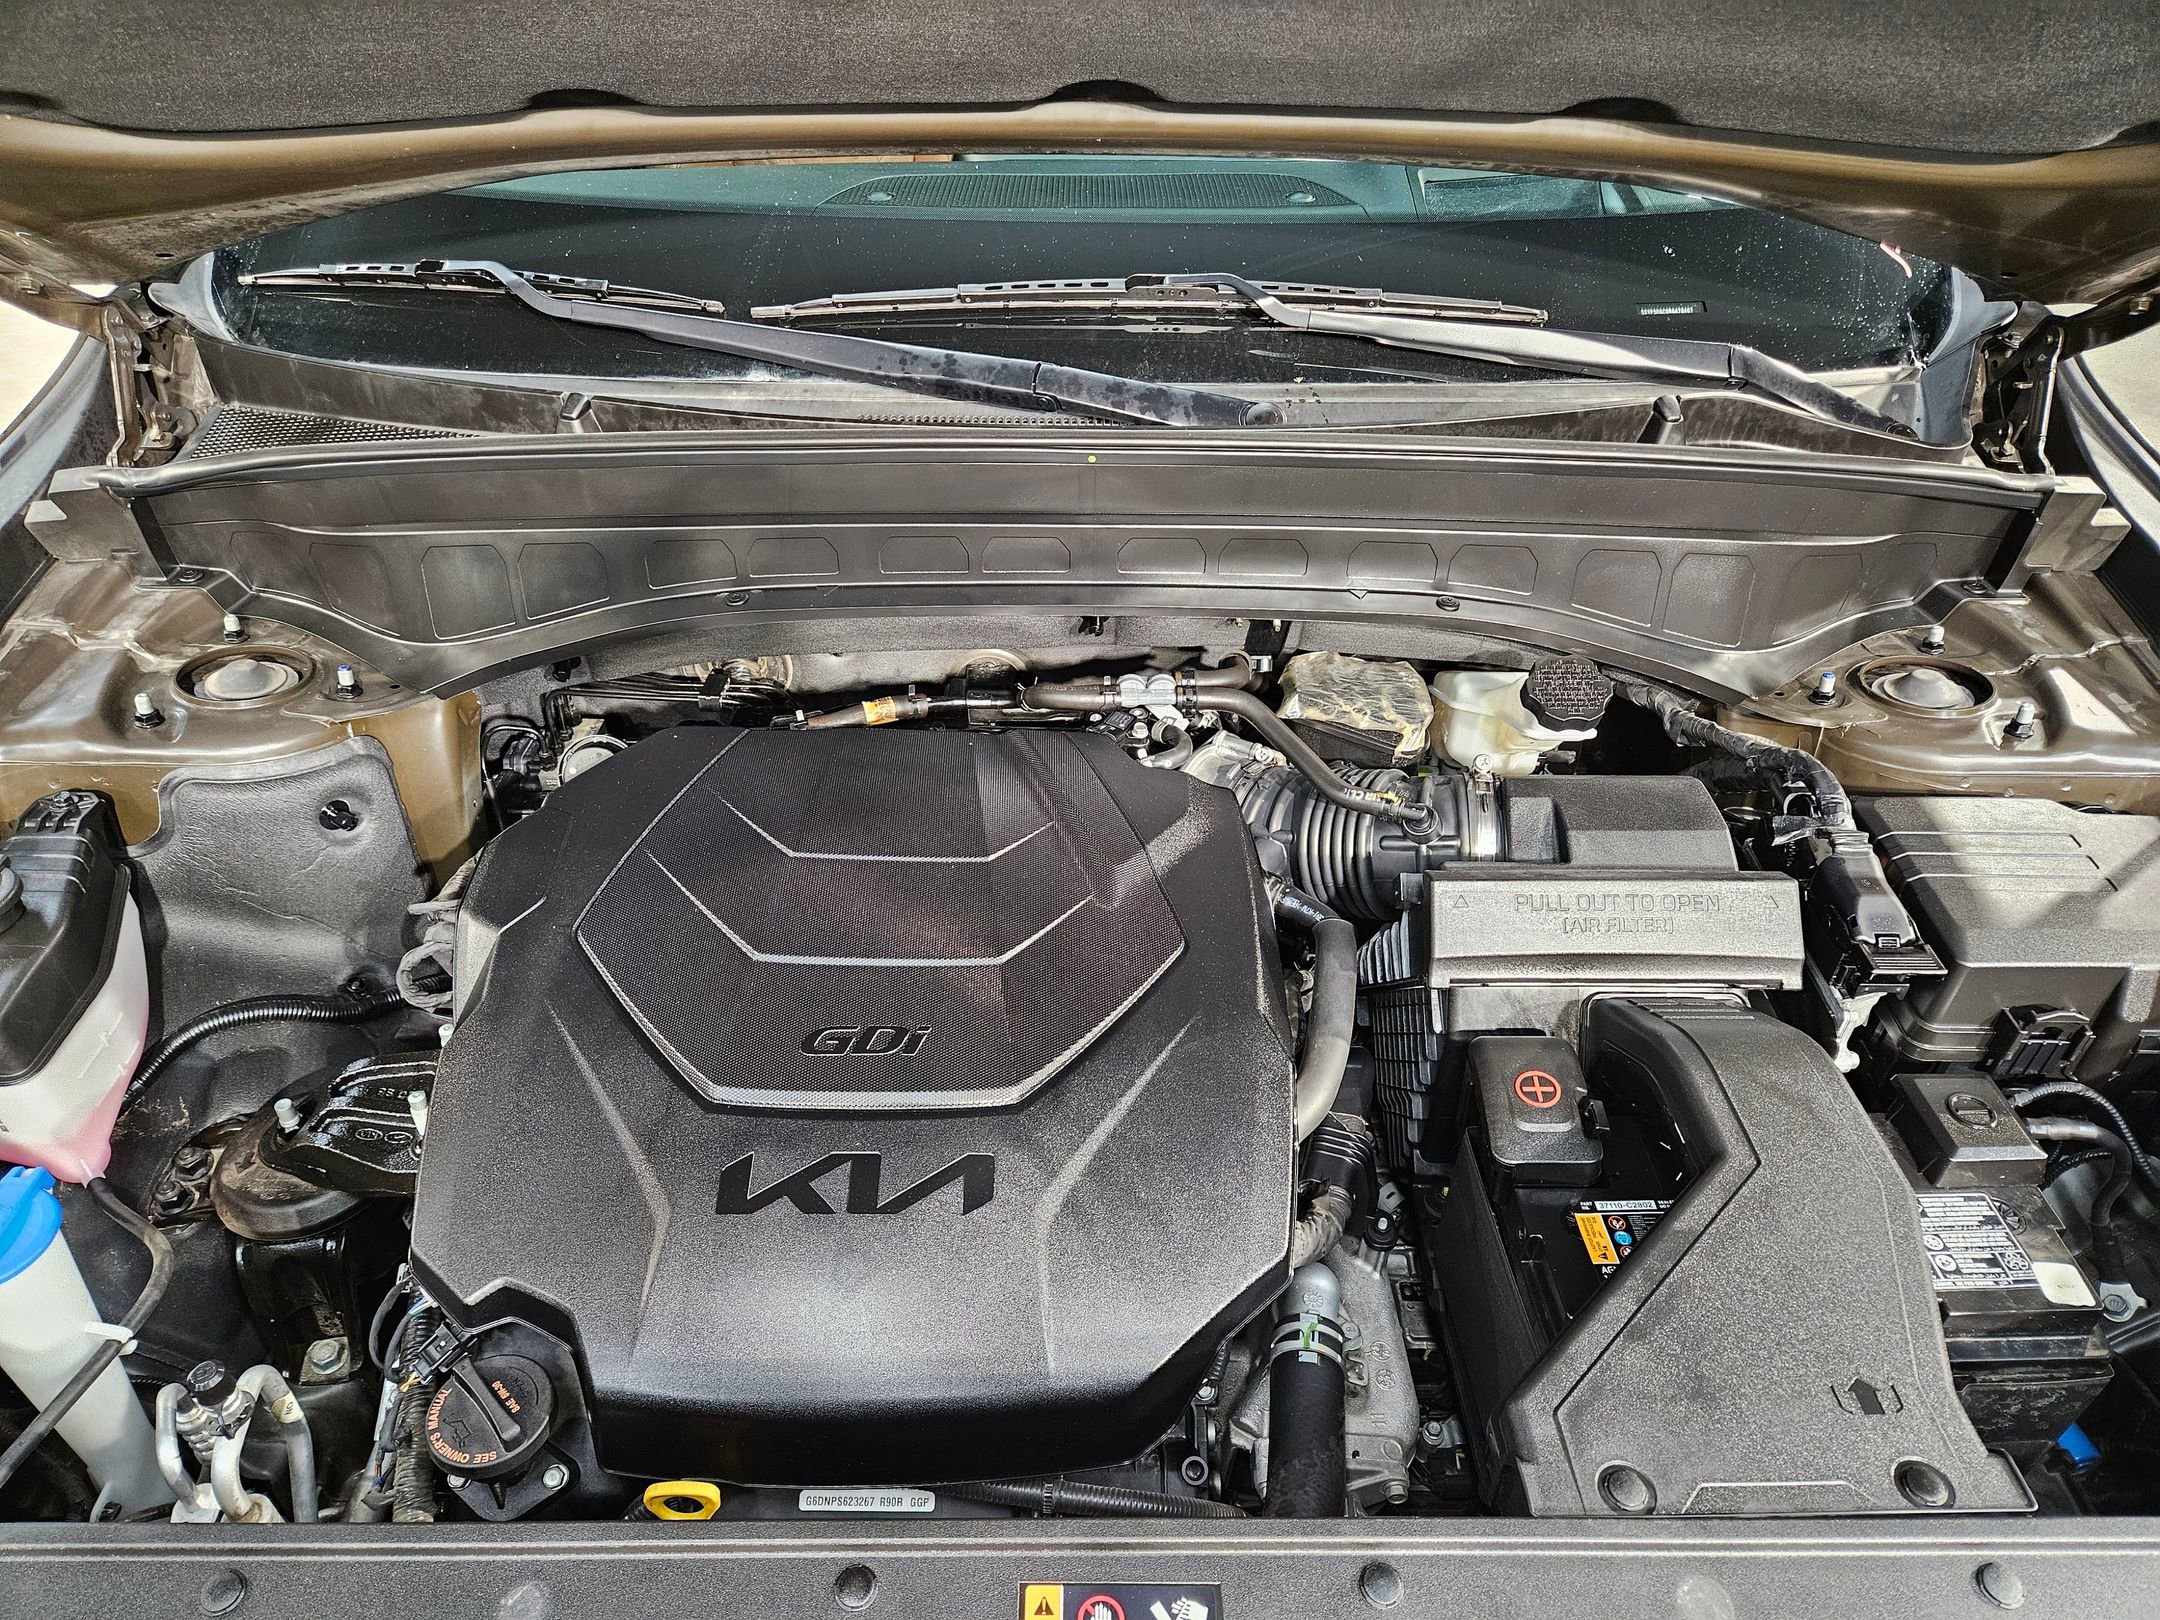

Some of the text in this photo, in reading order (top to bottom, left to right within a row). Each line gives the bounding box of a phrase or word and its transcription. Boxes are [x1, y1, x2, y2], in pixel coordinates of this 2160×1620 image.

[1513, 893, 1720, 912] PULL OUT TO OPEN
[715, 1152, 995, 1216] KIA
[505, 1398, 520, 1413] SAE
[427, 1387, 497, 1464] SEE OWNER'S MANUAL
[806, 1496, 875, 1507] G6DNPS623267
[880, 1496, 903, 1507] R90R
